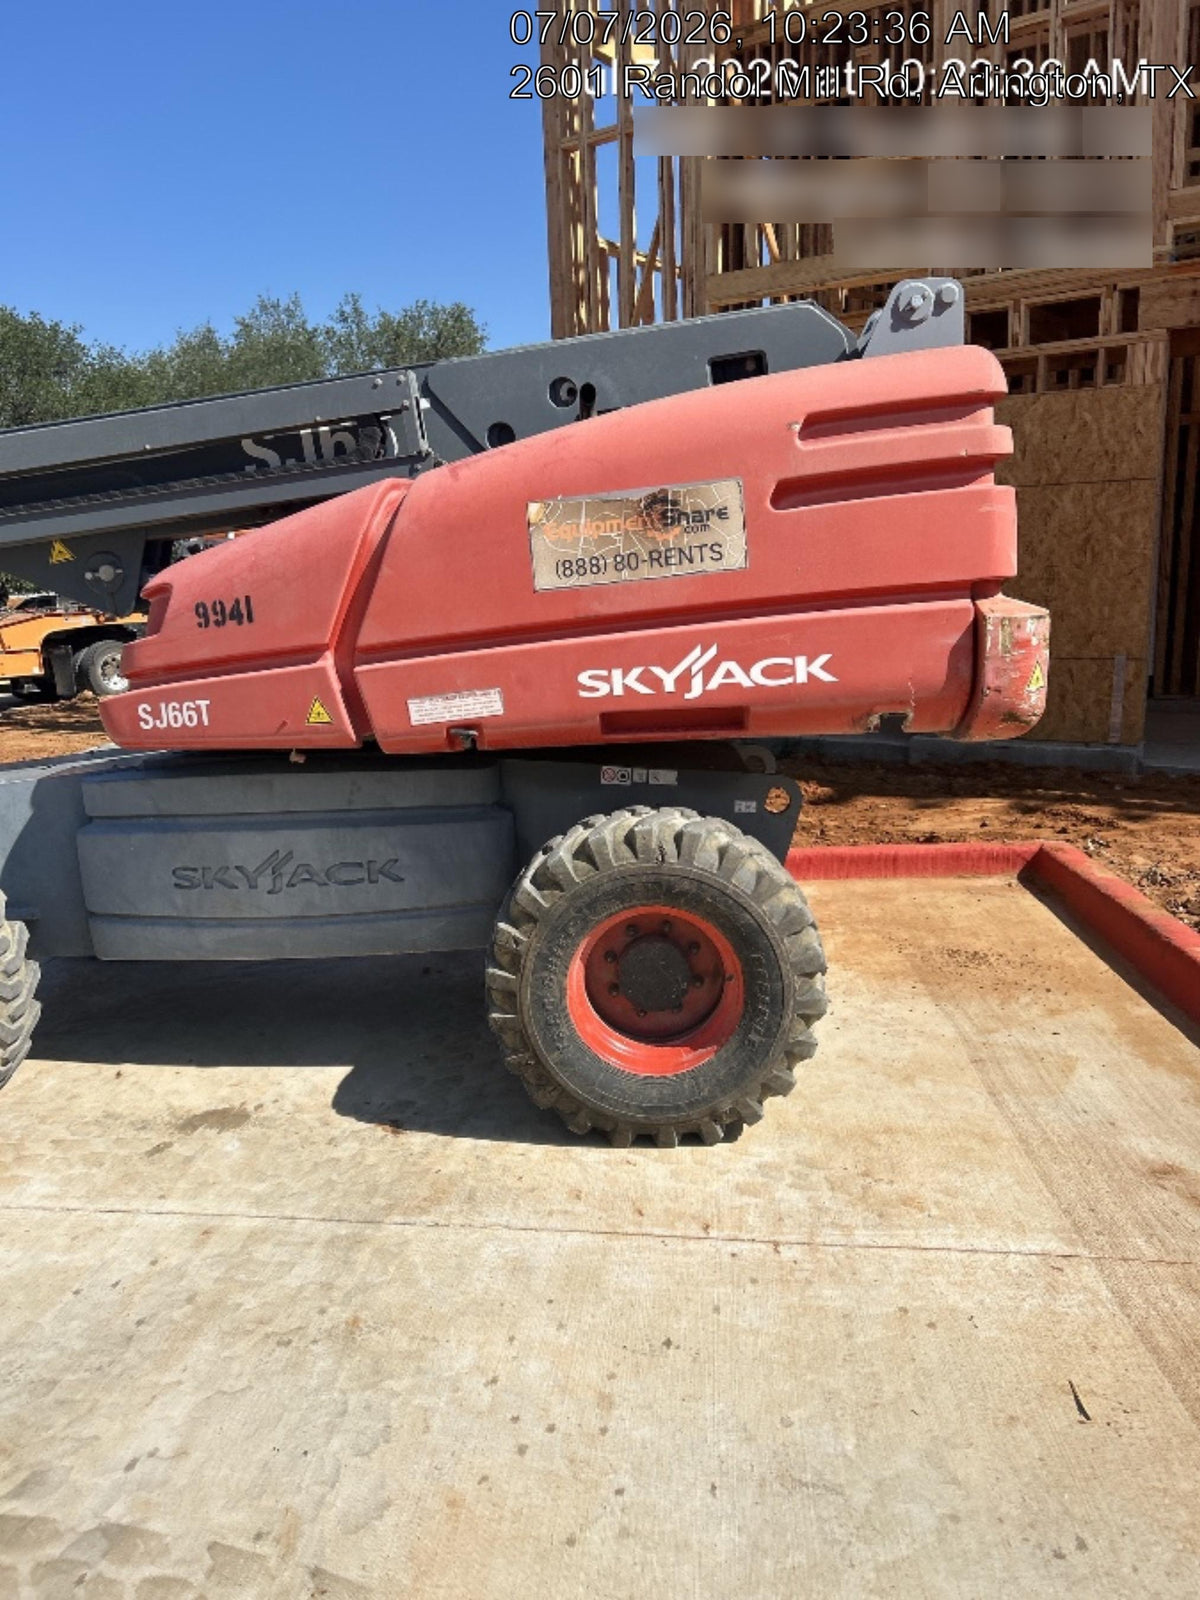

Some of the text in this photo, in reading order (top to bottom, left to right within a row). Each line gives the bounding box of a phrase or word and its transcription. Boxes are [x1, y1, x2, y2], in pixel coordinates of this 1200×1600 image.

[555, 543, 723, 580] (888) 80-RENTS
[194, 595, 254, 628] 9941
[577, 642, 839, 700] SKYJACK
[137, 699, 210, 730] SJ66T
[171, 850, 405, 895] SKYJACK
